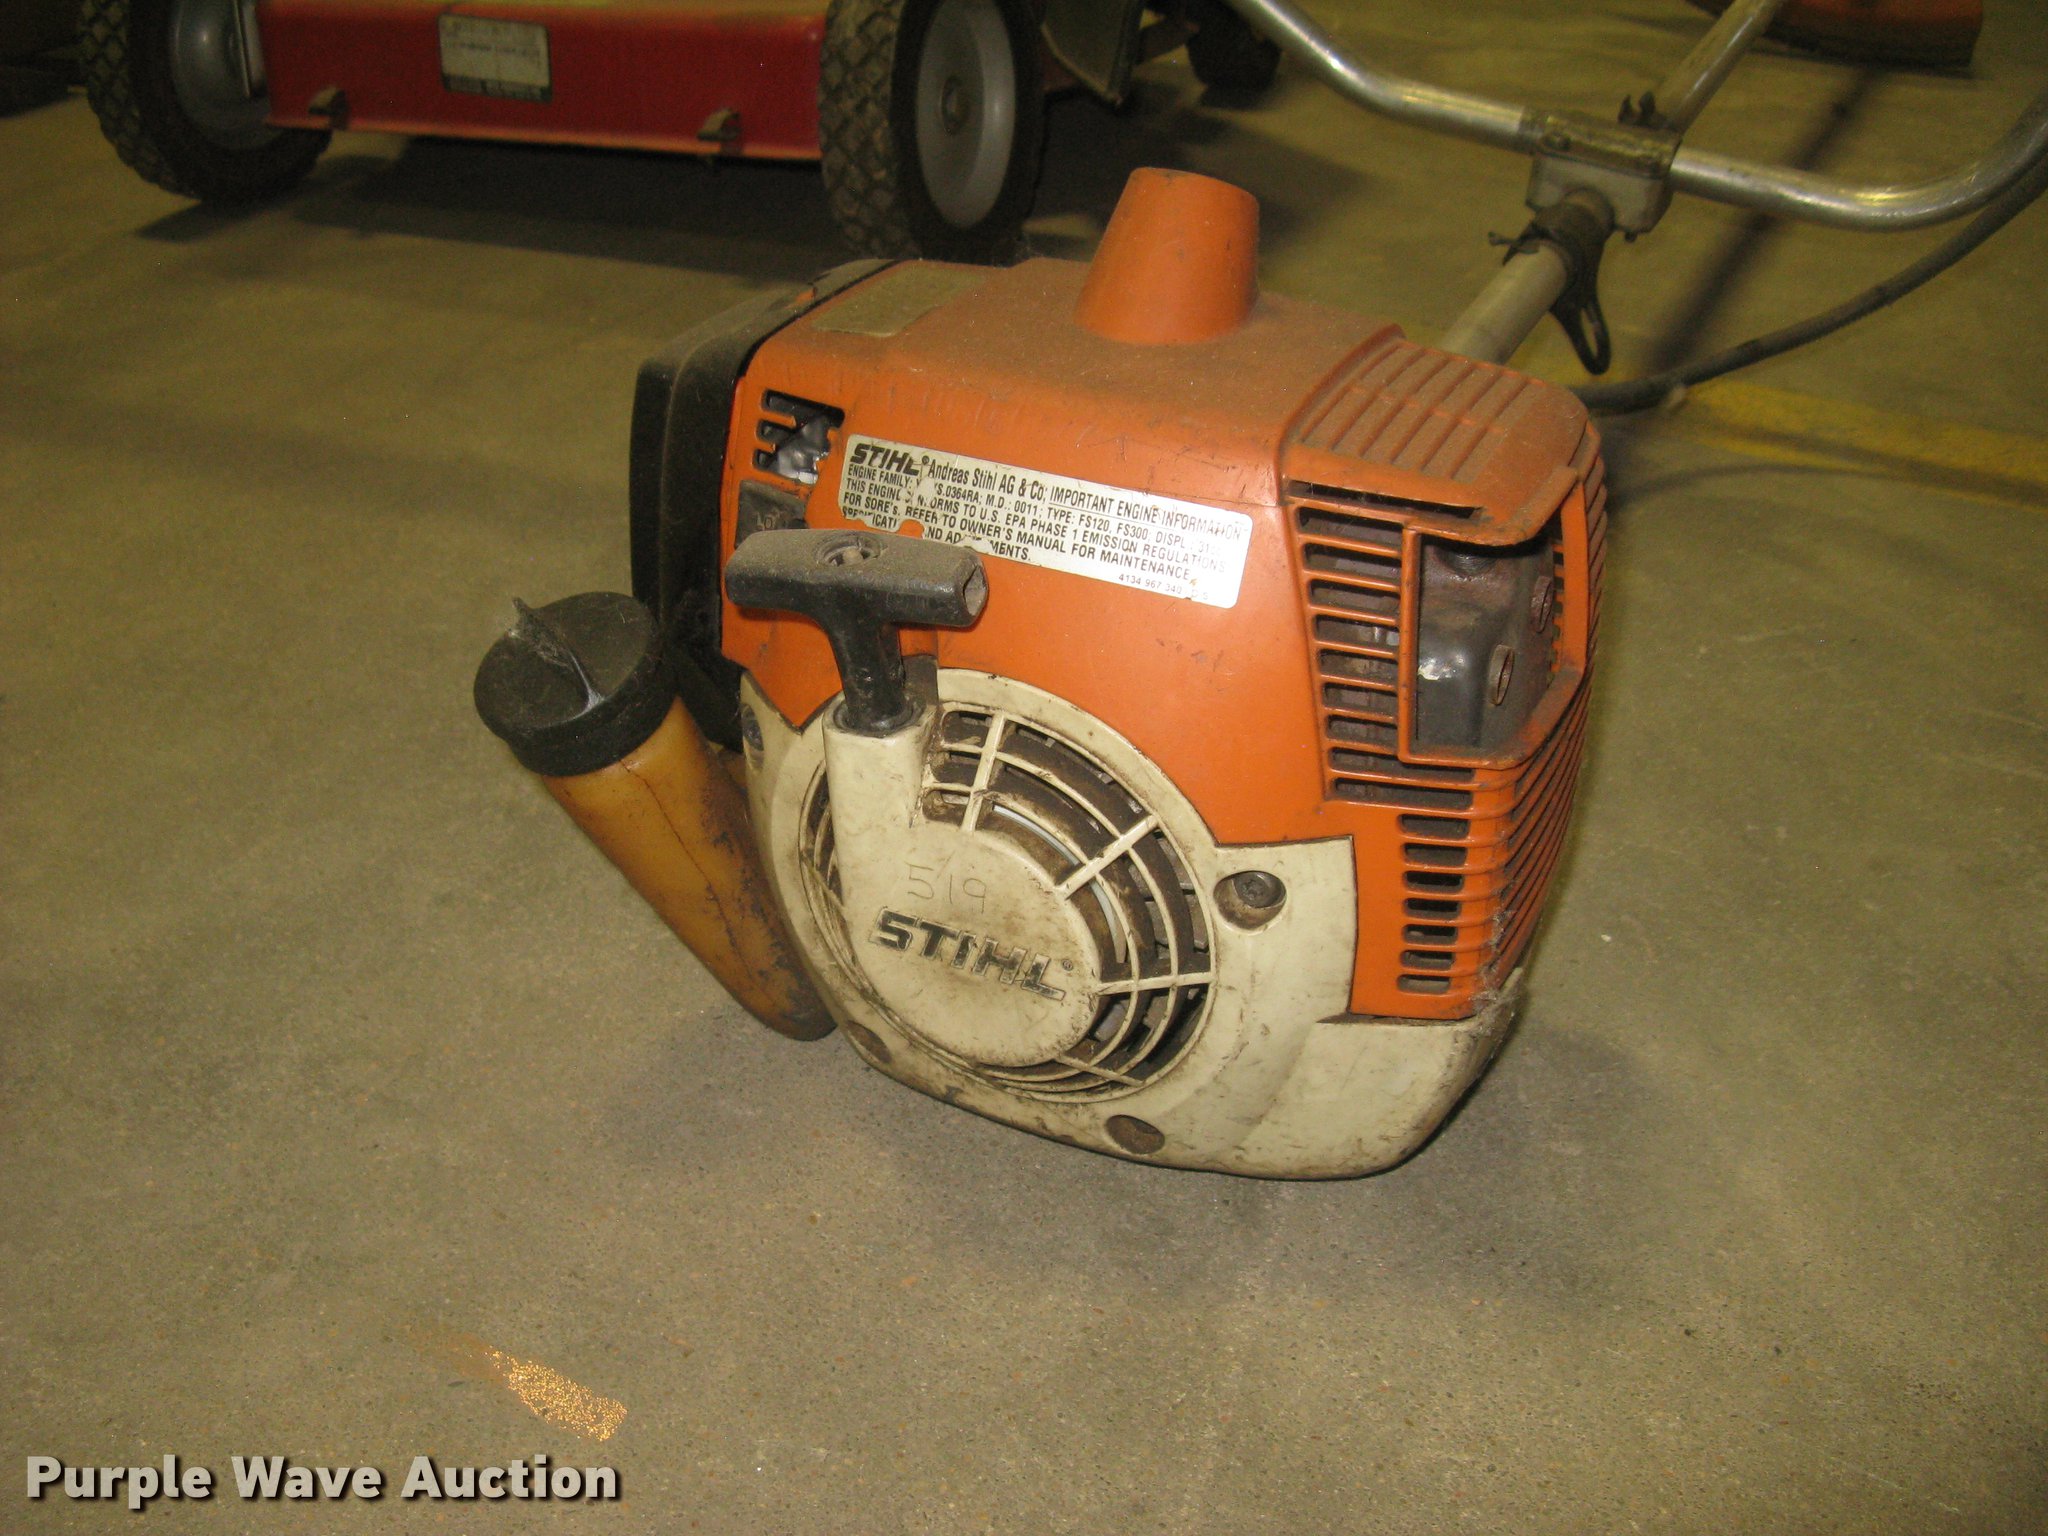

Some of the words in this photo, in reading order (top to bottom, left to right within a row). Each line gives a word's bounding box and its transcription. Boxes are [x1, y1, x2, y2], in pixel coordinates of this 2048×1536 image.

[843, 492, 862, 506] FOR
[905, 506, 938, 524] REFER
[942, 513, 957, 528] TO
[959, 518, 1013, 541] OWNER'S
[1016, 530, 1066, 553] MANUAL
[1070, 543, 1096, 560] FOR
[846, 478, 866, 493] THIS
[963, 503, 976, 518] TO
[980, 507, 1001, 523] U.S.
[1005, 513, 1026, 529] EPA
[1030, 519, 1068, 538] PHASE
[1073, 528, 1078, 541] 1
[1082, 530, 1138, 553] EMISSION
[1142, 543, 1226, 573] REGULATIONS
[848, 464, 877, 480] ENGINE
[879, 472, 913, 489] FAMILY:
[1047, 507, 1076, 525] TYPE:
[928, 459, 969, 485] Andreas
[973, 468, 998, 490] Stihl
[998, 474, 1016, 495] AG
[1018, 478, 1027, 497] &
[1050, 486, 1114, 513] IMPORTANT
[1117, 500, 1159, 524] ENGINE
[1161, 510, 1242, 541] INFORMATION
[1119, 573, 1142, 585] 4134
[1145, 578, 1162, 590] 967
[868, 906, 1067, 1002] STIHL
